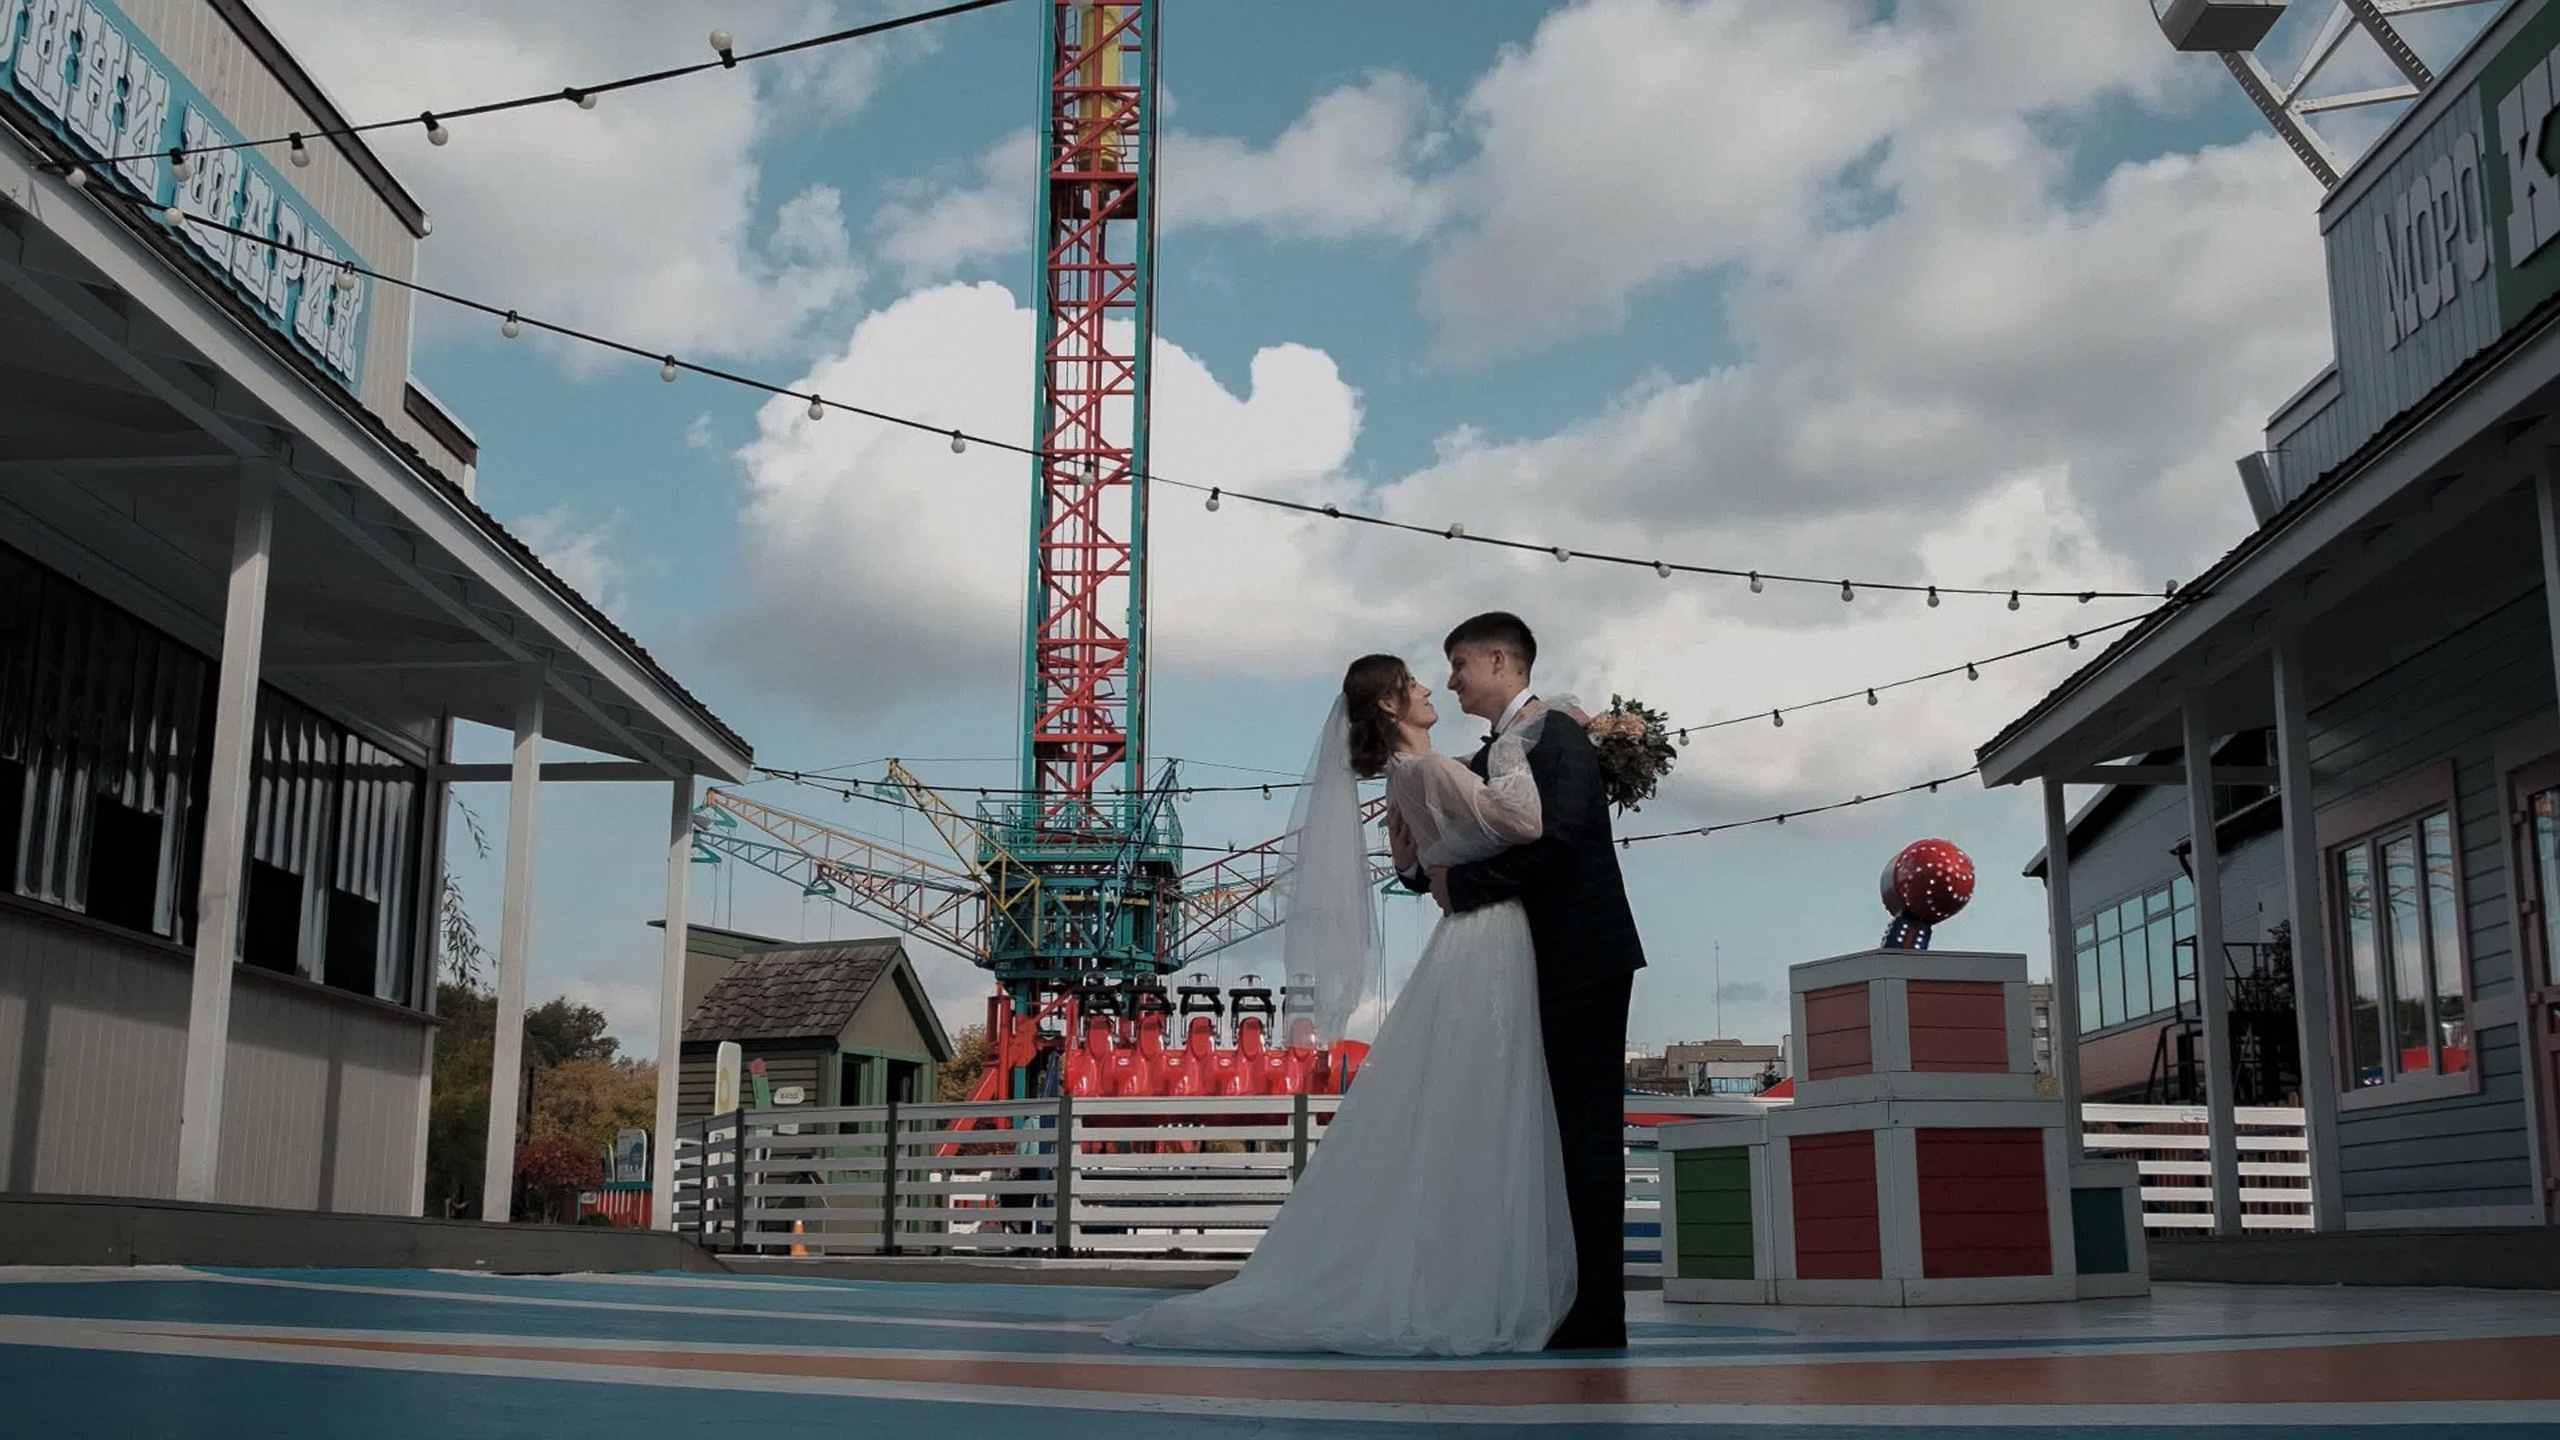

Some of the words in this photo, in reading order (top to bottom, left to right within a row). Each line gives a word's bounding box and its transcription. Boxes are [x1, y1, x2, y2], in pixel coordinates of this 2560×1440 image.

[0, 0, 172, 202] ПНИ
[174, 101, 364, 383] ШАРИК
[2374, 128, 2491, 351] МОРО
